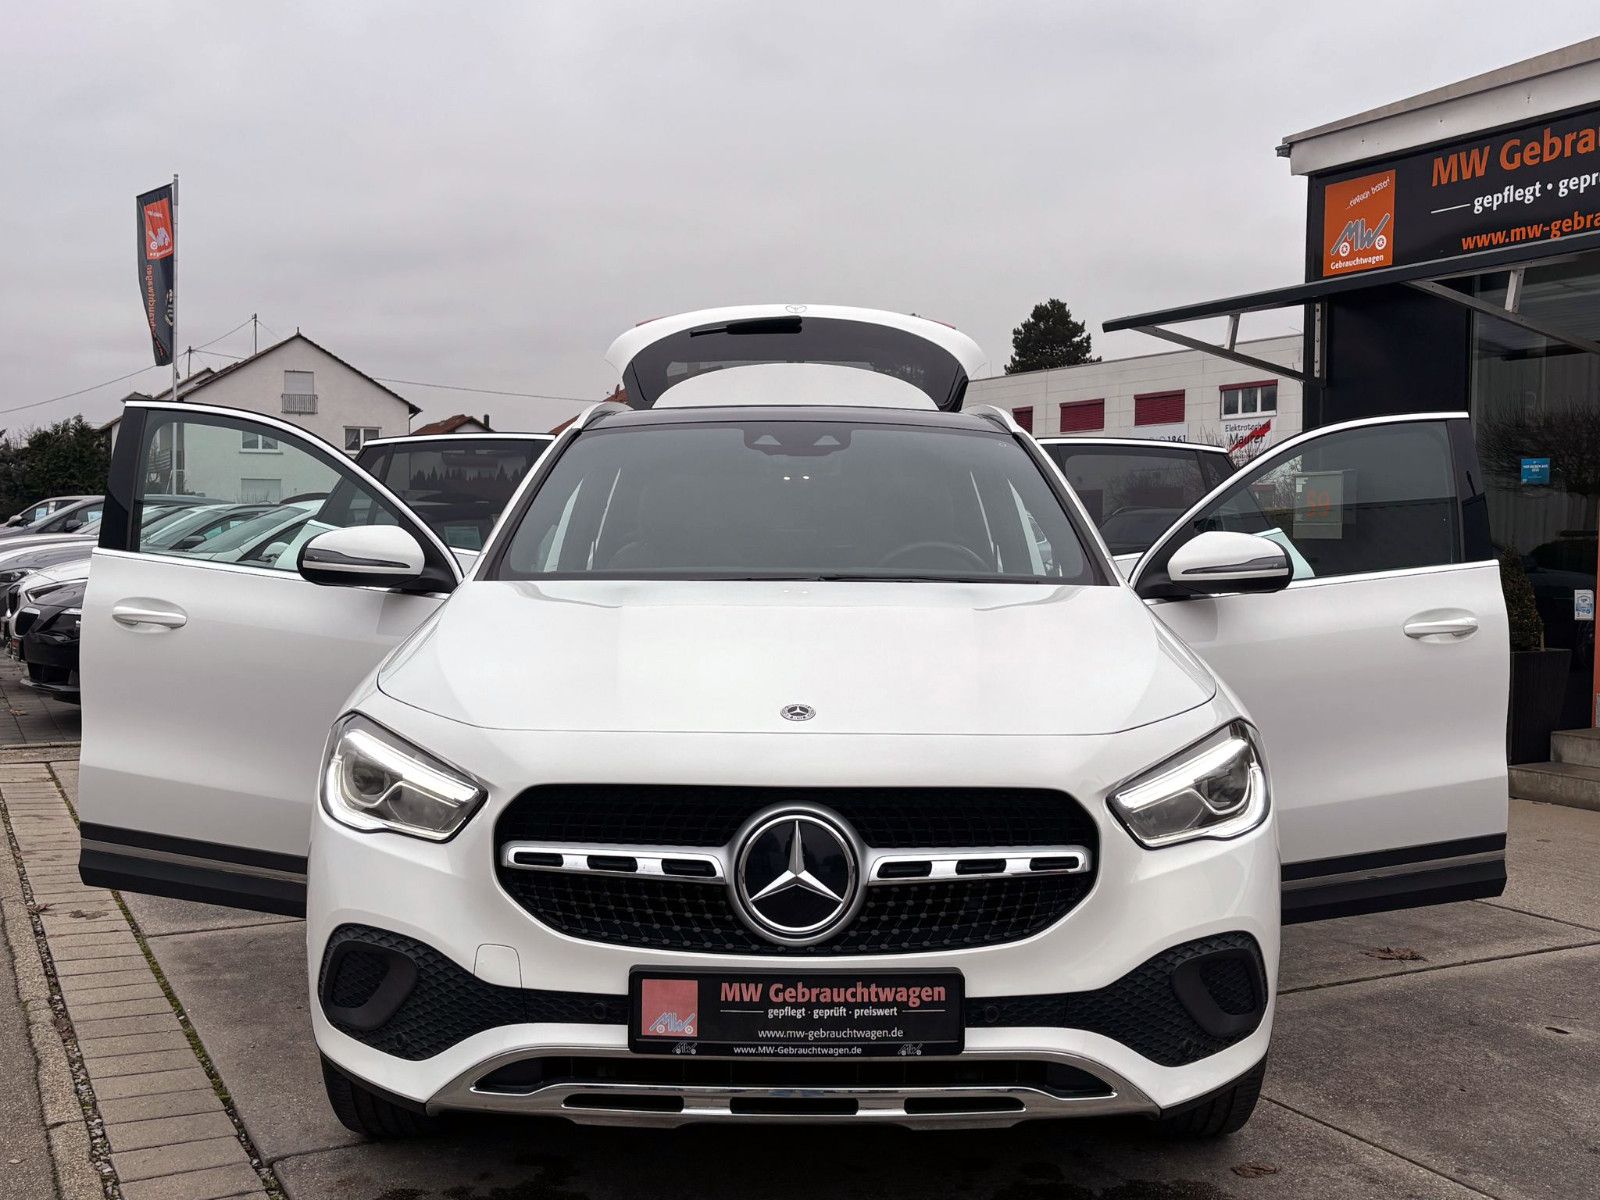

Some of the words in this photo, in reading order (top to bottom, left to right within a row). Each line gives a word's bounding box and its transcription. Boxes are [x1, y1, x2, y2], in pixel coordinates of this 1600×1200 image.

[1432, 145, 1490, 187] MW
[1499, 127, 1600, 171] Gebra
[1473, 181, 1542, 215] gepflegt
[1558, 172, 1600, 198] gepr
[1331, 213, 1391, 256] MW
[1330, 254, 1384, 270] Gebrauchtwagen
[720, 982, 763, 1002] MW
[769, 981, 946, 1008] Gebrauchtwagen
[649, 1012, 696, 1034] MW
[768, 1006, 806, 1019] gepflegt
[813, 1006, 847, 1019] geprüft
[854, 1006, 898, 1019] preiswert
[758, 1027, 904, 1040] www.mw-gebrauchtwagen.de
[733, 1045, 862, 1056] www.MW-Gebrauchtwagen.de
